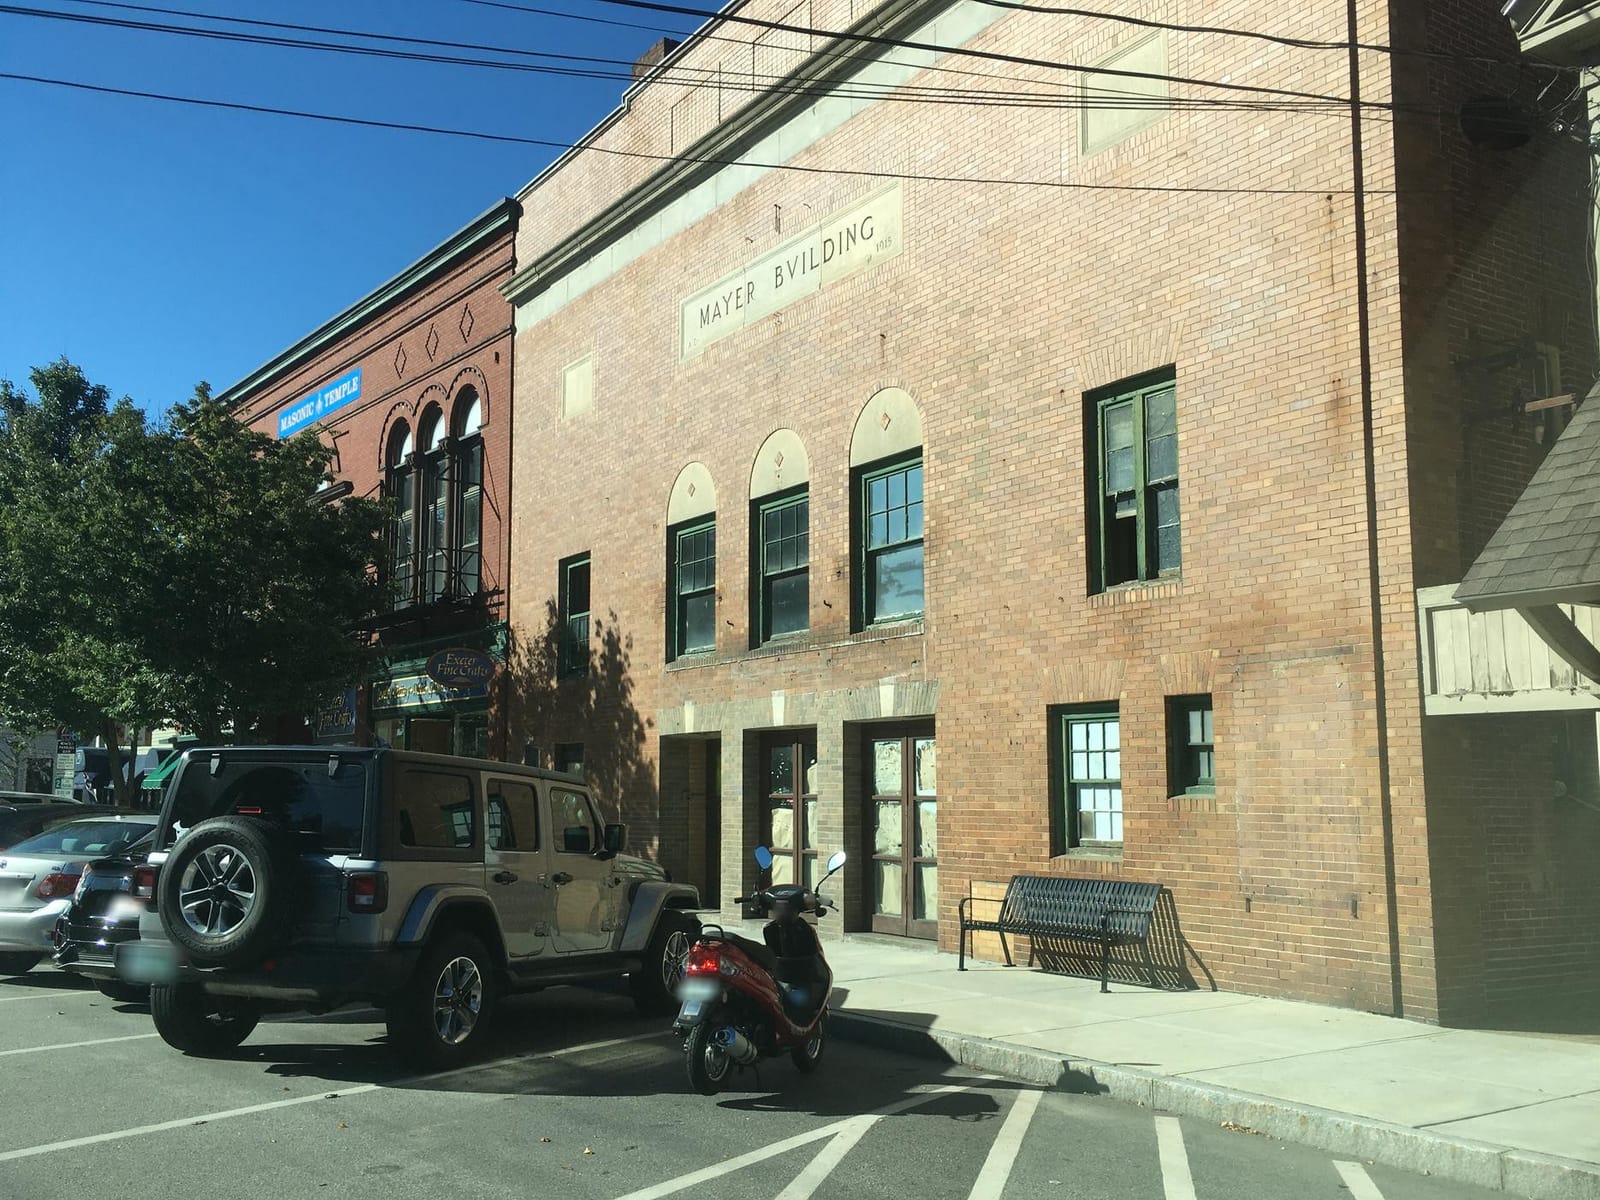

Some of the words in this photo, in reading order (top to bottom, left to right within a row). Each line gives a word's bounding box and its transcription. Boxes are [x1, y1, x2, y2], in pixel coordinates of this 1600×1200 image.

[700, 281, 755, 329] MAYER
[774, 215, 875, 289] BVILDING
[280, 401, 315, 432] MASONIC
[323, 376, 359, 408] TEMPLE
[436, 663, 457, 676] Fine
[459, 664, 488, 677] Crafts
[446, 653, 476, 666] Exeter
